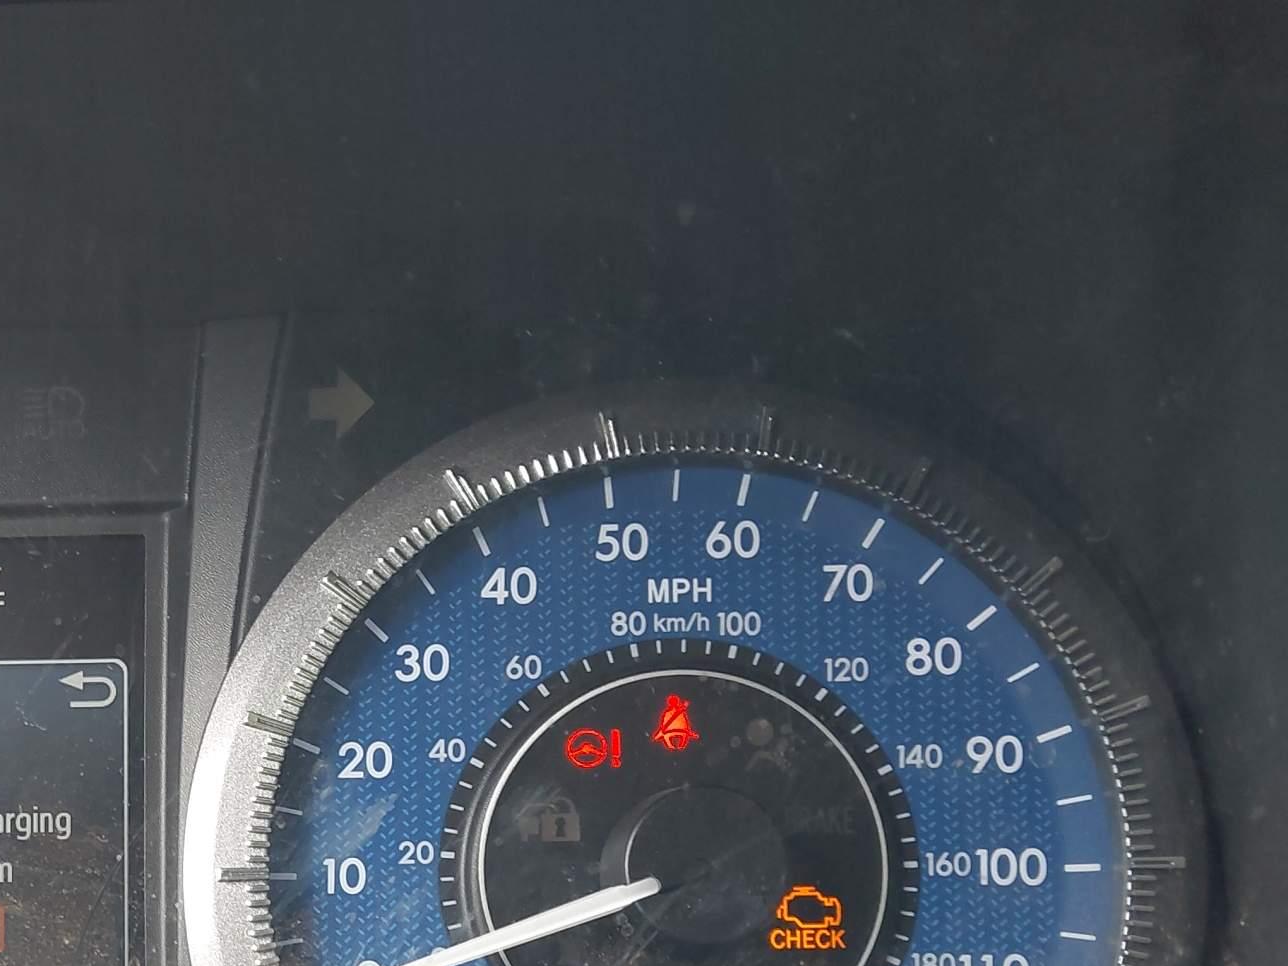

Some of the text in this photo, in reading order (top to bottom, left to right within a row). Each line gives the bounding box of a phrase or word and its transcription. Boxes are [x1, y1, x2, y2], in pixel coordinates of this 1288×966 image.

[595, 523, 648, 561] 50
[705, 520, 760, 559] 60
[481, 567, 537, 605] 40
[647, 578, 712, 603] MPH
[822, 563, 873, 602] 70
[611, 611, 761, 636] 80 km/h 100
[394, 644, 450, 682] 30
[505, 655, 542, 680] 60
[823, 658, 869, 683] 120
[906, 637, 962, 675] 80
[337, 741, 393, 779] 20
[428, 738, 466, 763] 40
[896, 744, 943, 769] 140
[966, 736, 1024, 774] 90
[398, 841, 435, 866] 20
[926, 852, 972, 876] 160
[975, 848, 1048, 887] 100
[322, 858, 367, 895] 10
[769, 929, 846, 949] CHECK
